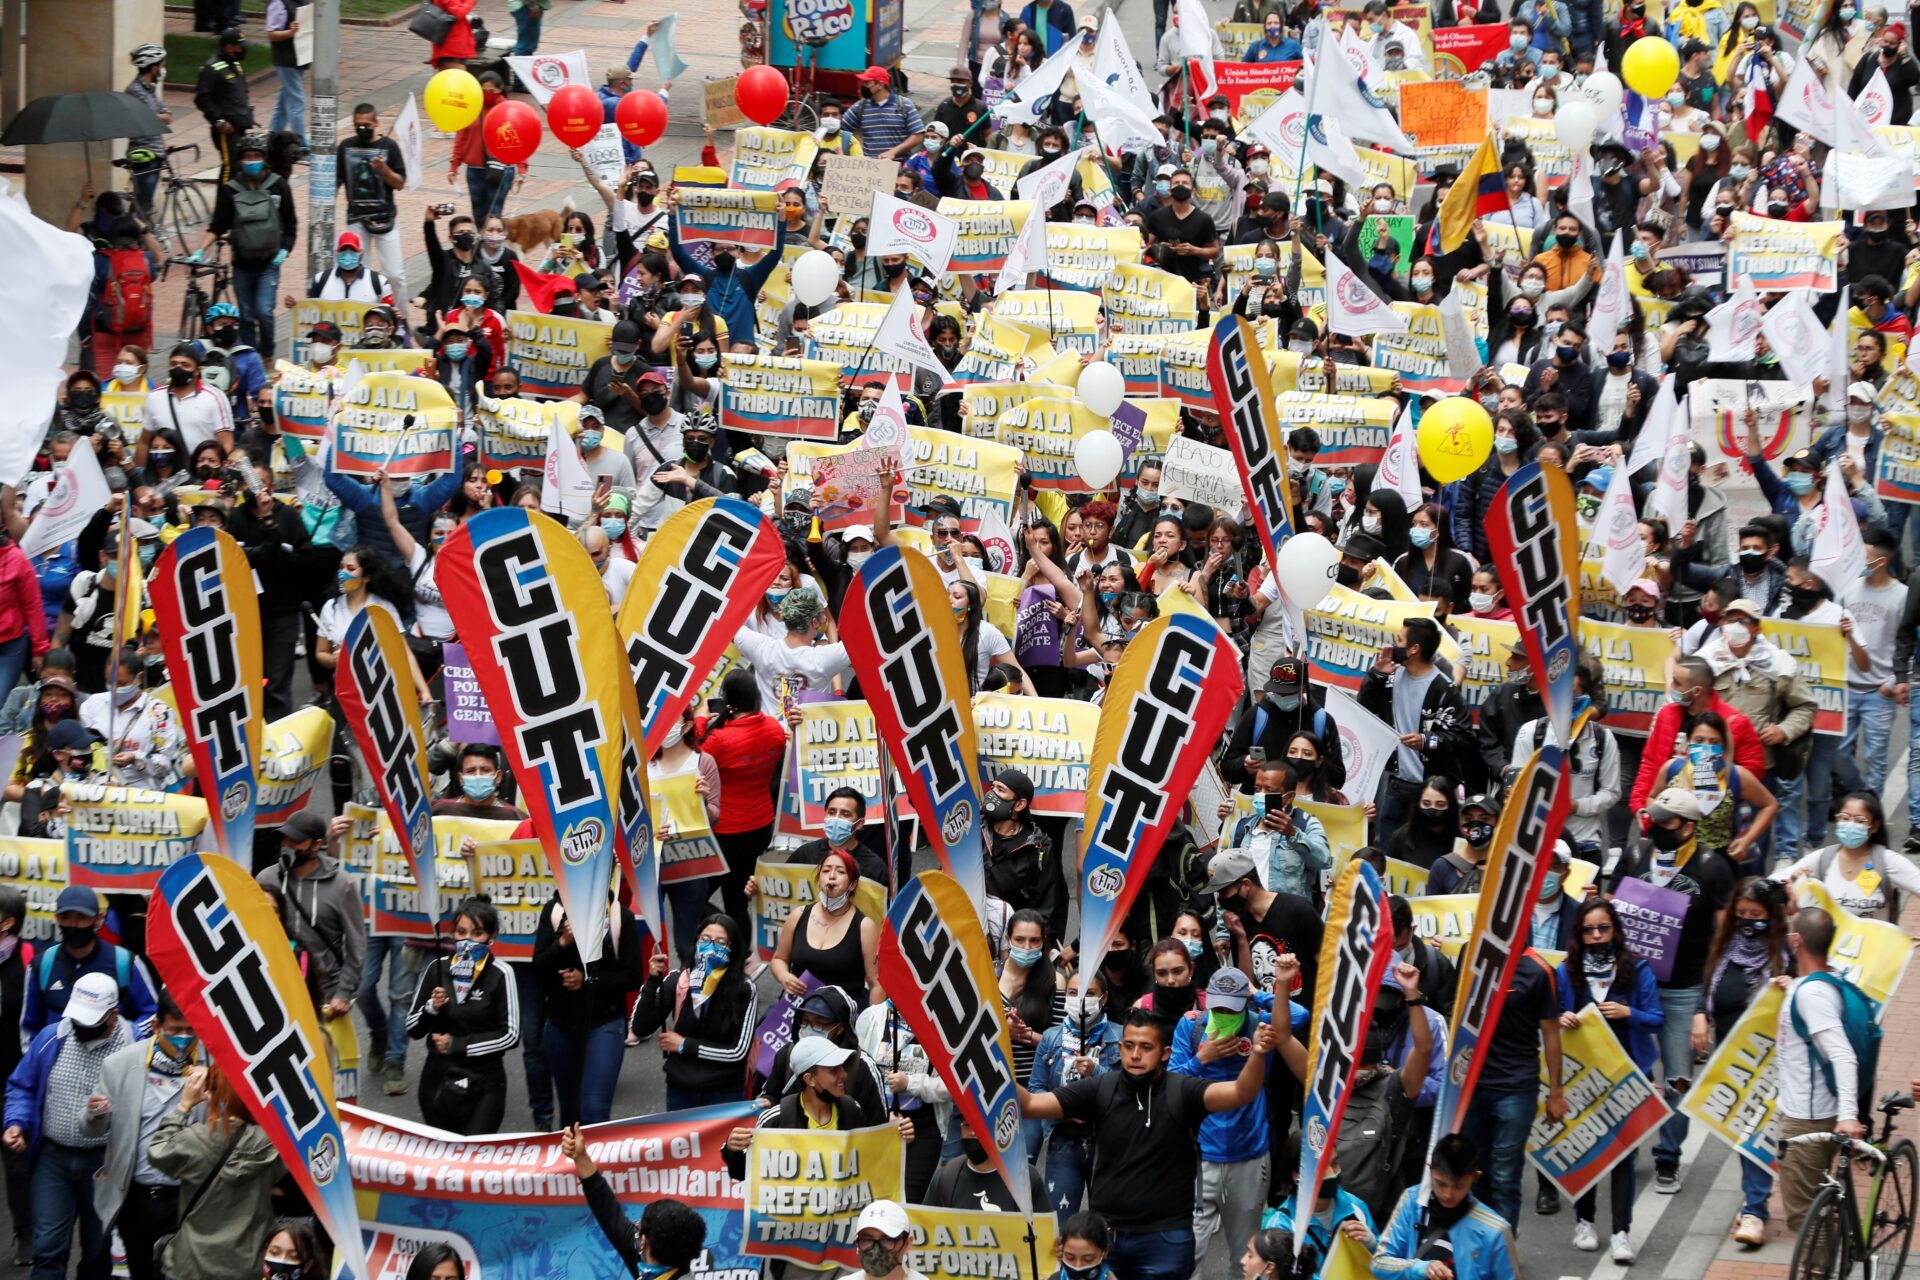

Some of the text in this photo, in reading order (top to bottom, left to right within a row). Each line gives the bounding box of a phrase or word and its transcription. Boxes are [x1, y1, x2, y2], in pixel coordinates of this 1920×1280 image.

[784, 0, 847, 17] Todo
[791, 12, 853, 40] Rico
[683, 192, 755, 210] REFORMA
[684, 208, 775, 231] TRIBUTARIA
[957, 217, 1014, 236] EFORMA
[1054, 234, 1107, 250] NO A LA
[1048, 251, 1117, 270] REFORMA
[1106, 277, 1161, 300] NO A LA
[340, 311, 359, 327] LA
[817, 308, 842, 326] NO
[847, 311, 859, 328] A
[999, 300, 1063, 316] NO A LA
[1105, 299, 1170, 318] REFORMA
[518, 321, 576, 346] NO A LA
[512, 342, 587, 367] REFORMA
[730, 353, 802, 371] NO A LA
[813, 347, 911, 374] TRIBUTARIA
[728, 368, 813, 395] REFORMA
[1301, 365, 1372, 392] REFRMA
[349, 387, 417, 410] NO A LA
[727, 391, 835, 419] TRIBUTARIA
[972, 396, 996, 417] NO
[505, 405, 544, 425] A LA
[1007, 406, 1073, 434] NO A LA
[1286, 405, 1365, 424] REFORMA
[1220, 325, 1288, 536] CUT
[911, 440, 978, 470] NO A LA
[908, 463, 986, 497] REFORMA
[1505, 470, 1573, 653] CUT
[627, 507, 761, 729] CUT
[1018, 611, 1052, 635] PODER
[1345, 602, 1358, 618] A
[1362, 604, 1387, 623] LA
[1018, 636, 1051, 656] GENTE
[1022, 623, 1049, 644] DE LA
[176, 541, 252, 779] CUT
[1607, 639, 1633, 662] LA
[473, 524, 609, 815] CUT
[865, 556, 966, 806] CUT
[456, 696, 478, 708] DE
[349, 616, 421, 825] CUT
[806, 718, 857, 744] NO A
[980, 706, 1068, 734] NO A LA
[979, 732, 1083, 762] REFORMA
[1095, 625, 1216, 862] CUT
[73, 807, 180, 836] REFORMA
[25, 855, 42, 880] A
[482, 854, 537, 878] NO A
[762, 877, 814, 901] NO A
[1460, 762, 1562, 1037] CUT
[1444, 912, 1462, 937] A
[1662, 914, 1683, 929] EL
[1641, 933, 1664, 946] LA
[171, 865, 326, 1141] CUT
[897, 885, 1011, 1117] CUT
[1700, 1031, 1777, 1122] NO A LA
[1542, 1075, 1652, 1173] TRIBUTARIA
[358, 1125, 541, 1166] democracia
[670, 1132, 702, 1159] el
[761, 1148, 859, 1180] NO A LA
[412, 1165, 432, 1191] y
[435, 1165, 465, 1192] la
[602, 1166, 746, 1199] tributaria
[759, 1181, 874, 1215] REFORMA
[935, 1224, 998, 1249] A LA
